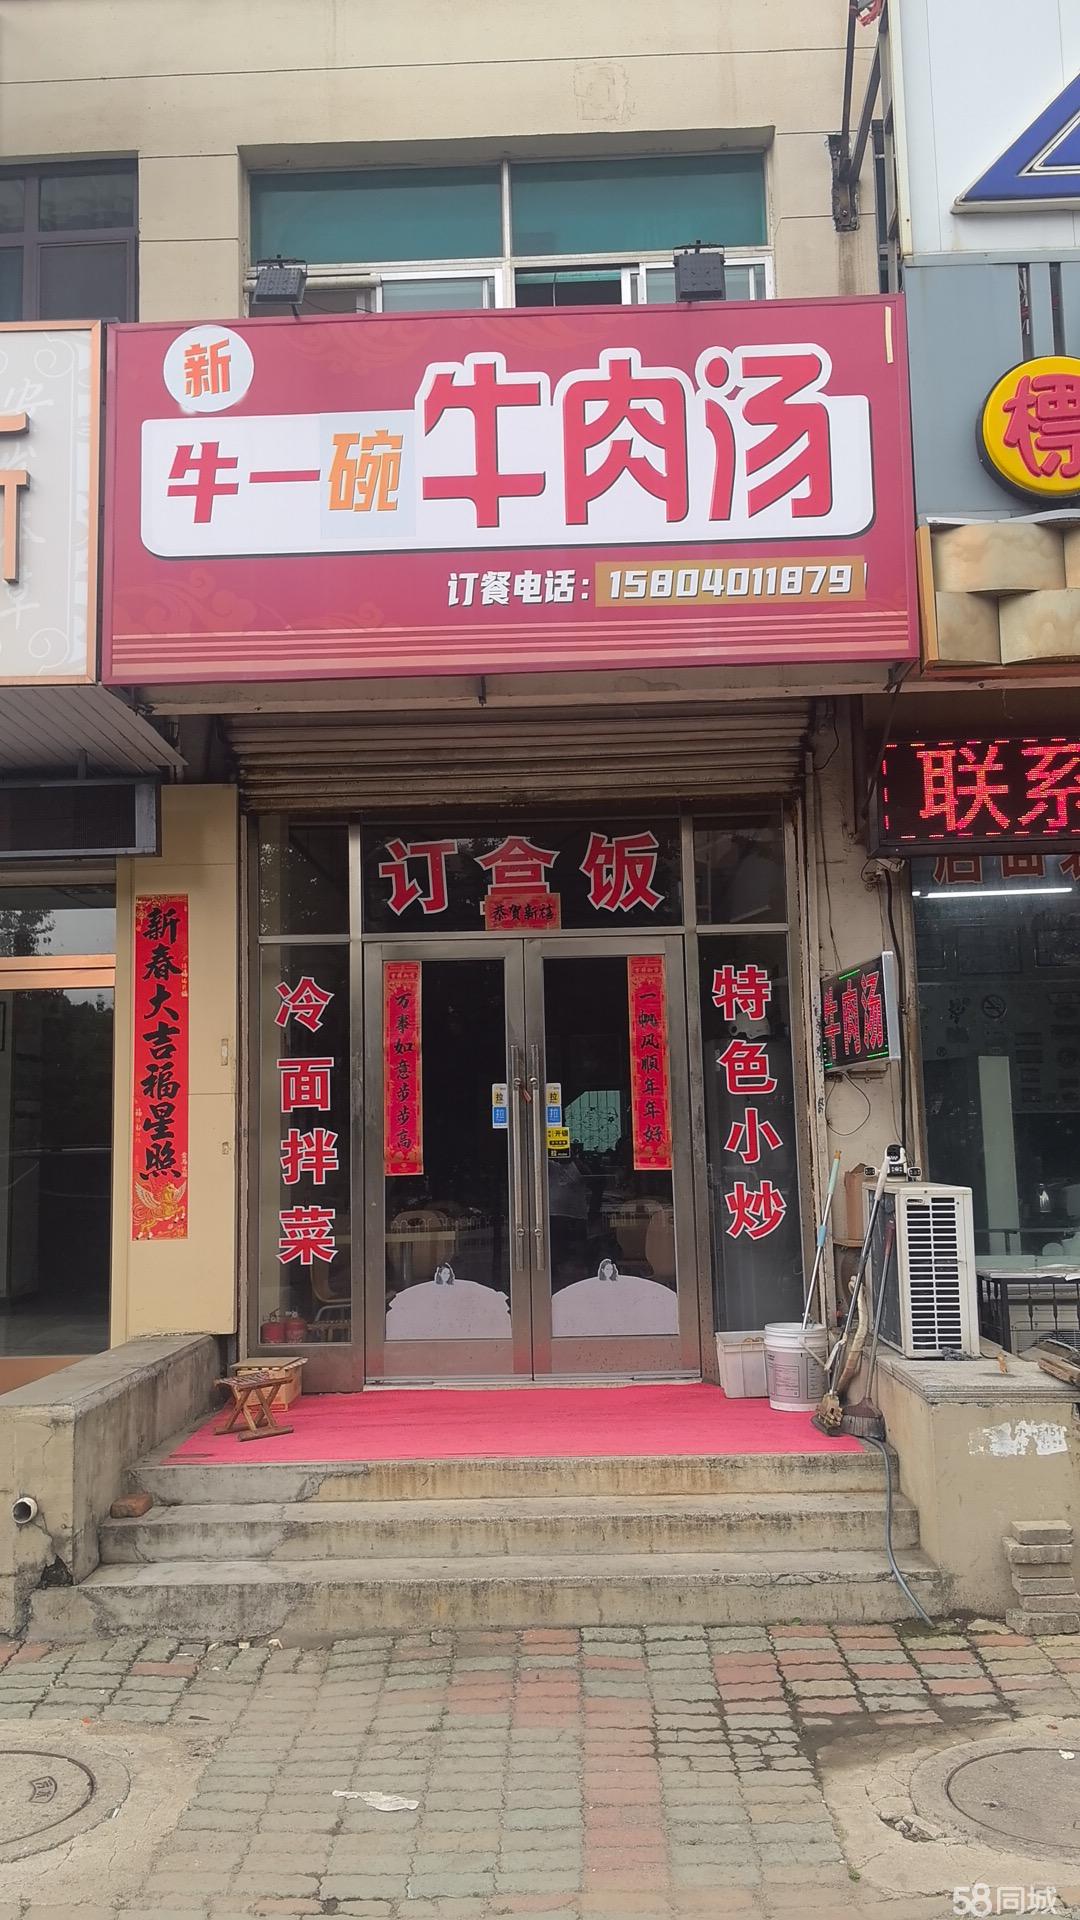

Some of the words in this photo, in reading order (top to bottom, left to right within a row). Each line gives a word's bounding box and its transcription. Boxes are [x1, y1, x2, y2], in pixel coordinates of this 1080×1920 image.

[185, 339, 232, 398] 新
[609, 564, 853, 599] 15804011879
[916, 744, 1080, 831] 联系
[140, 906, 183, 1181] 新春大吉福星照
[637, 992, 663, 1143] 一帆风顺年年好
[711, 964, 787, 1241] 特色小炒
[274, 976, 339, 1265] 冷面拌菜
